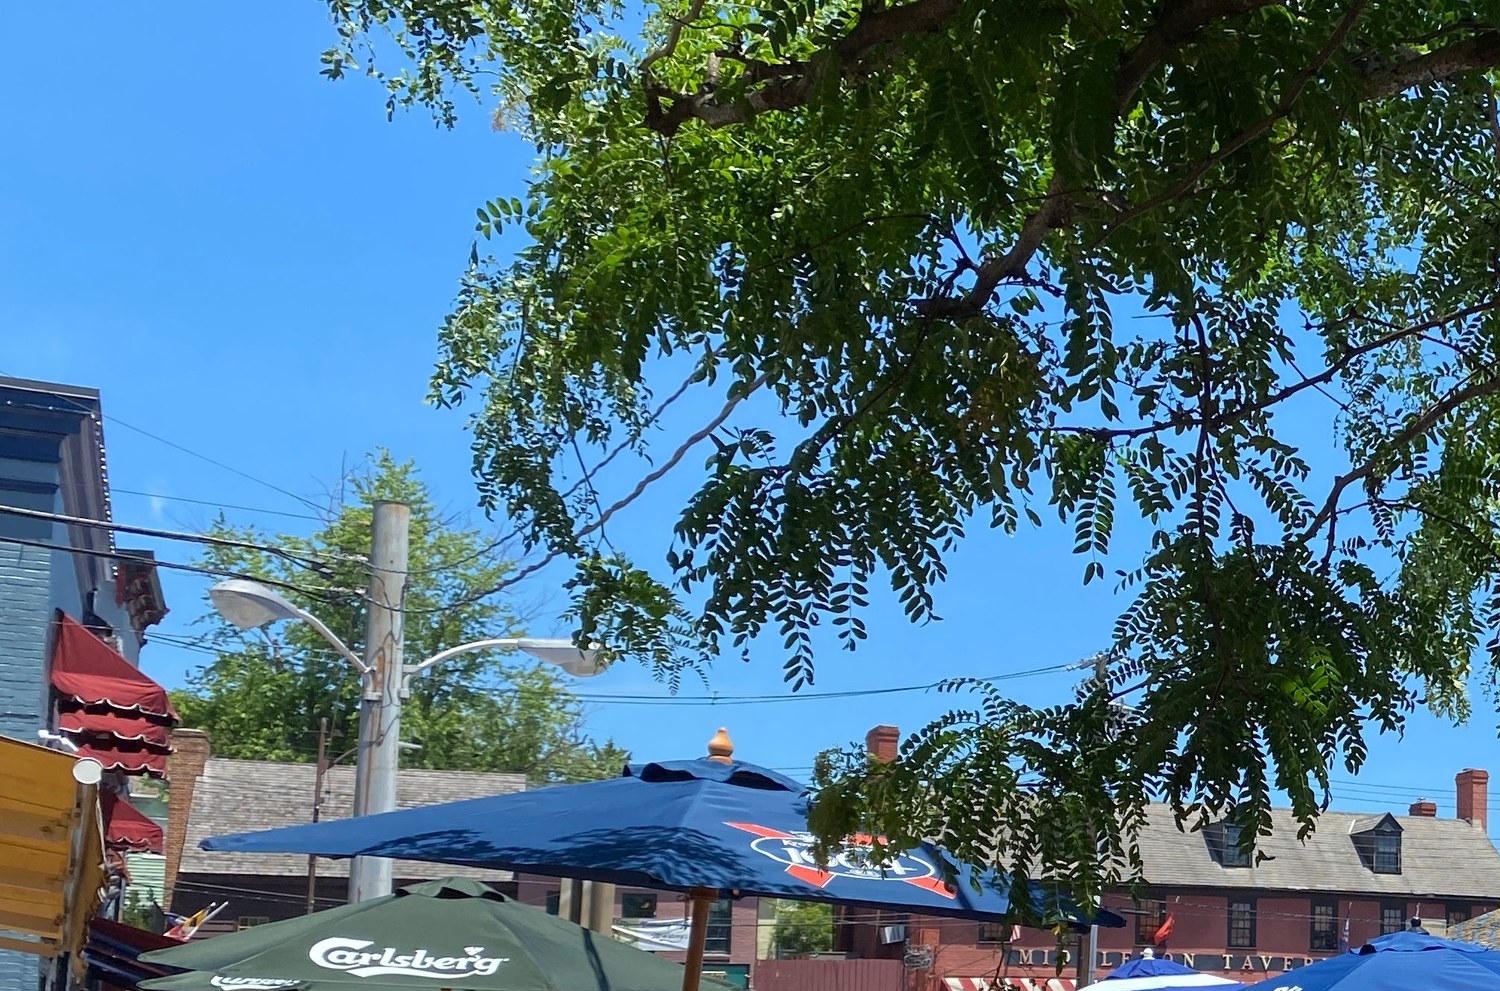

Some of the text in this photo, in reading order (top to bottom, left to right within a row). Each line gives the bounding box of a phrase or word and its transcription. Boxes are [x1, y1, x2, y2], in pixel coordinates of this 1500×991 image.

[308, 937, 510, 978] Carlsberg
[1019, 949, 1327, 972] MIDLEON TAVER
